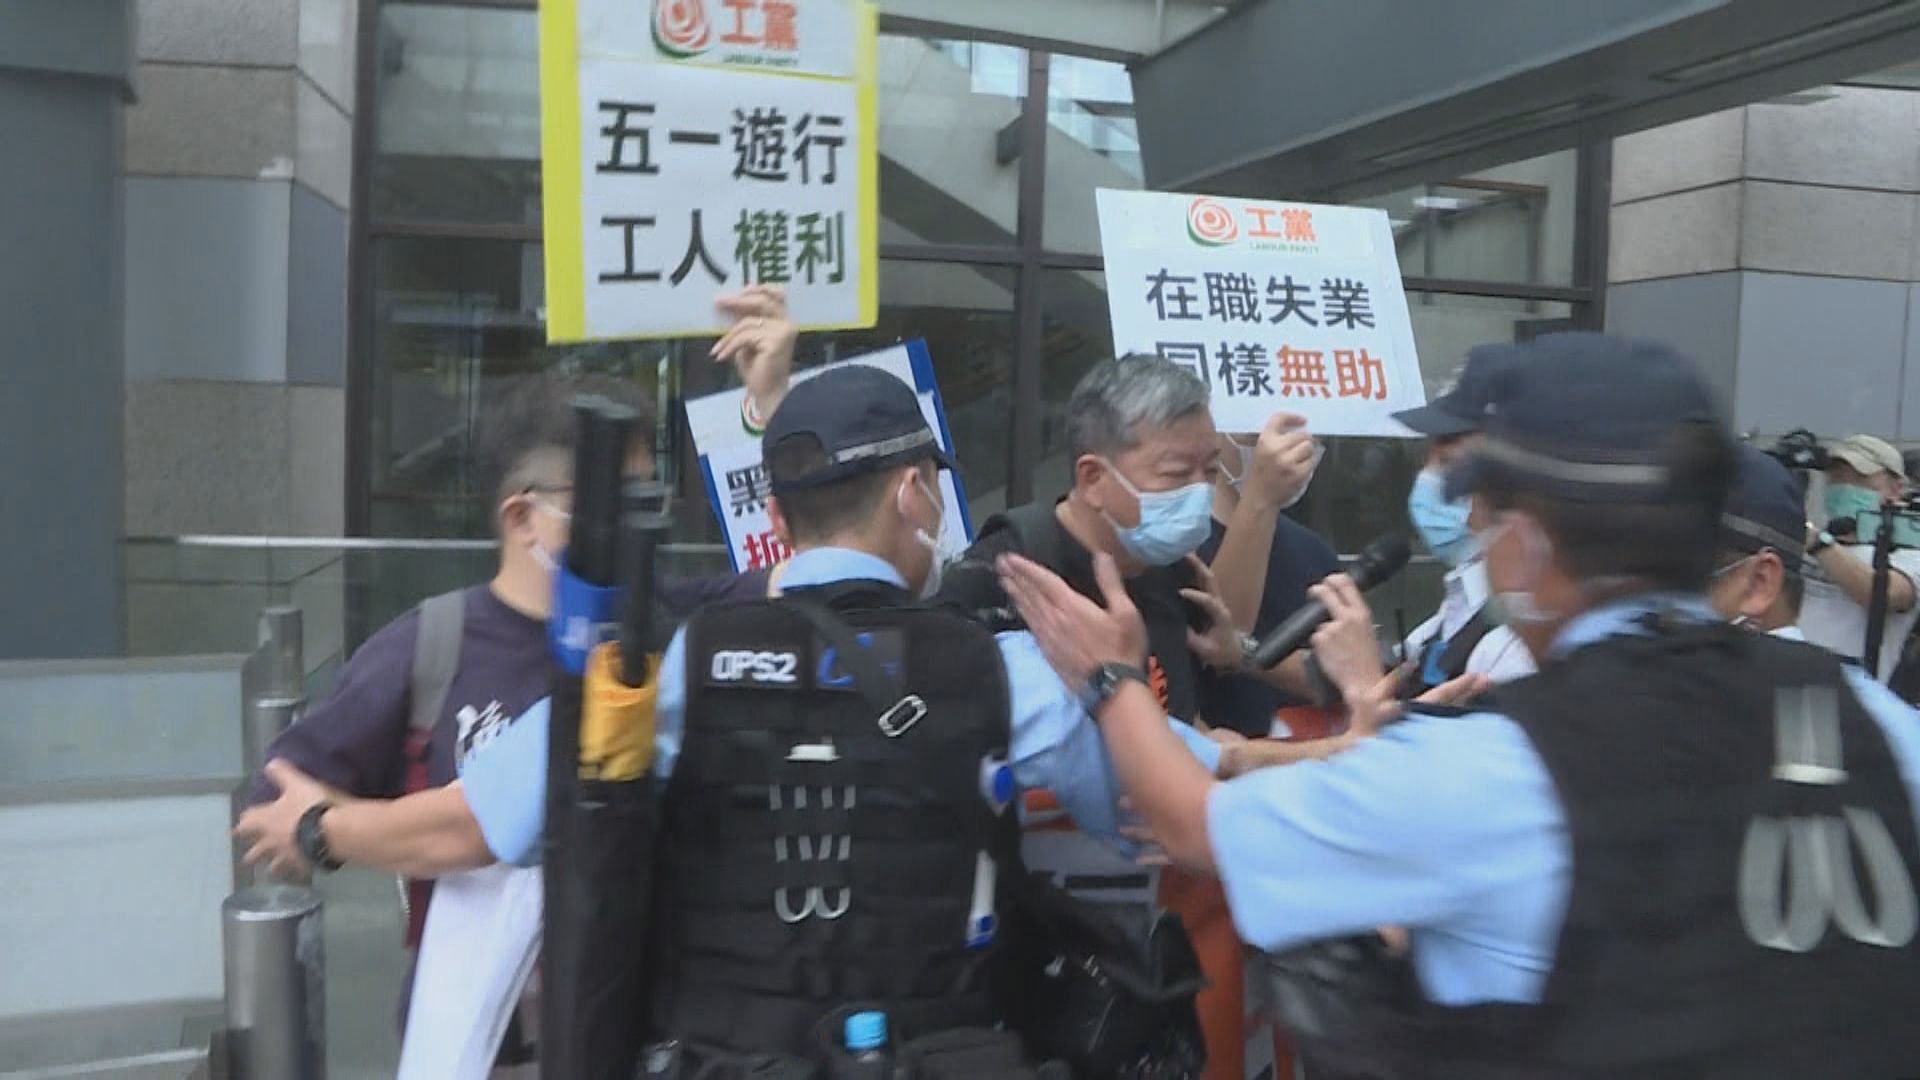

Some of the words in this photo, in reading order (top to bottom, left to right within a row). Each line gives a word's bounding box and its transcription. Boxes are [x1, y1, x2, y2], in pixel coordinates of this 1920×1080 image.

[719, 0, 799, 50] 工黨
[595, 101, 847, 184] 五一遊行
[598, 207, 846, 287] 工人權利
[1244, 206, 1317, 243] 工黨
[1145, 268, 1375, 329] 在職失業
[711, 650, 797, 682] OPS2
